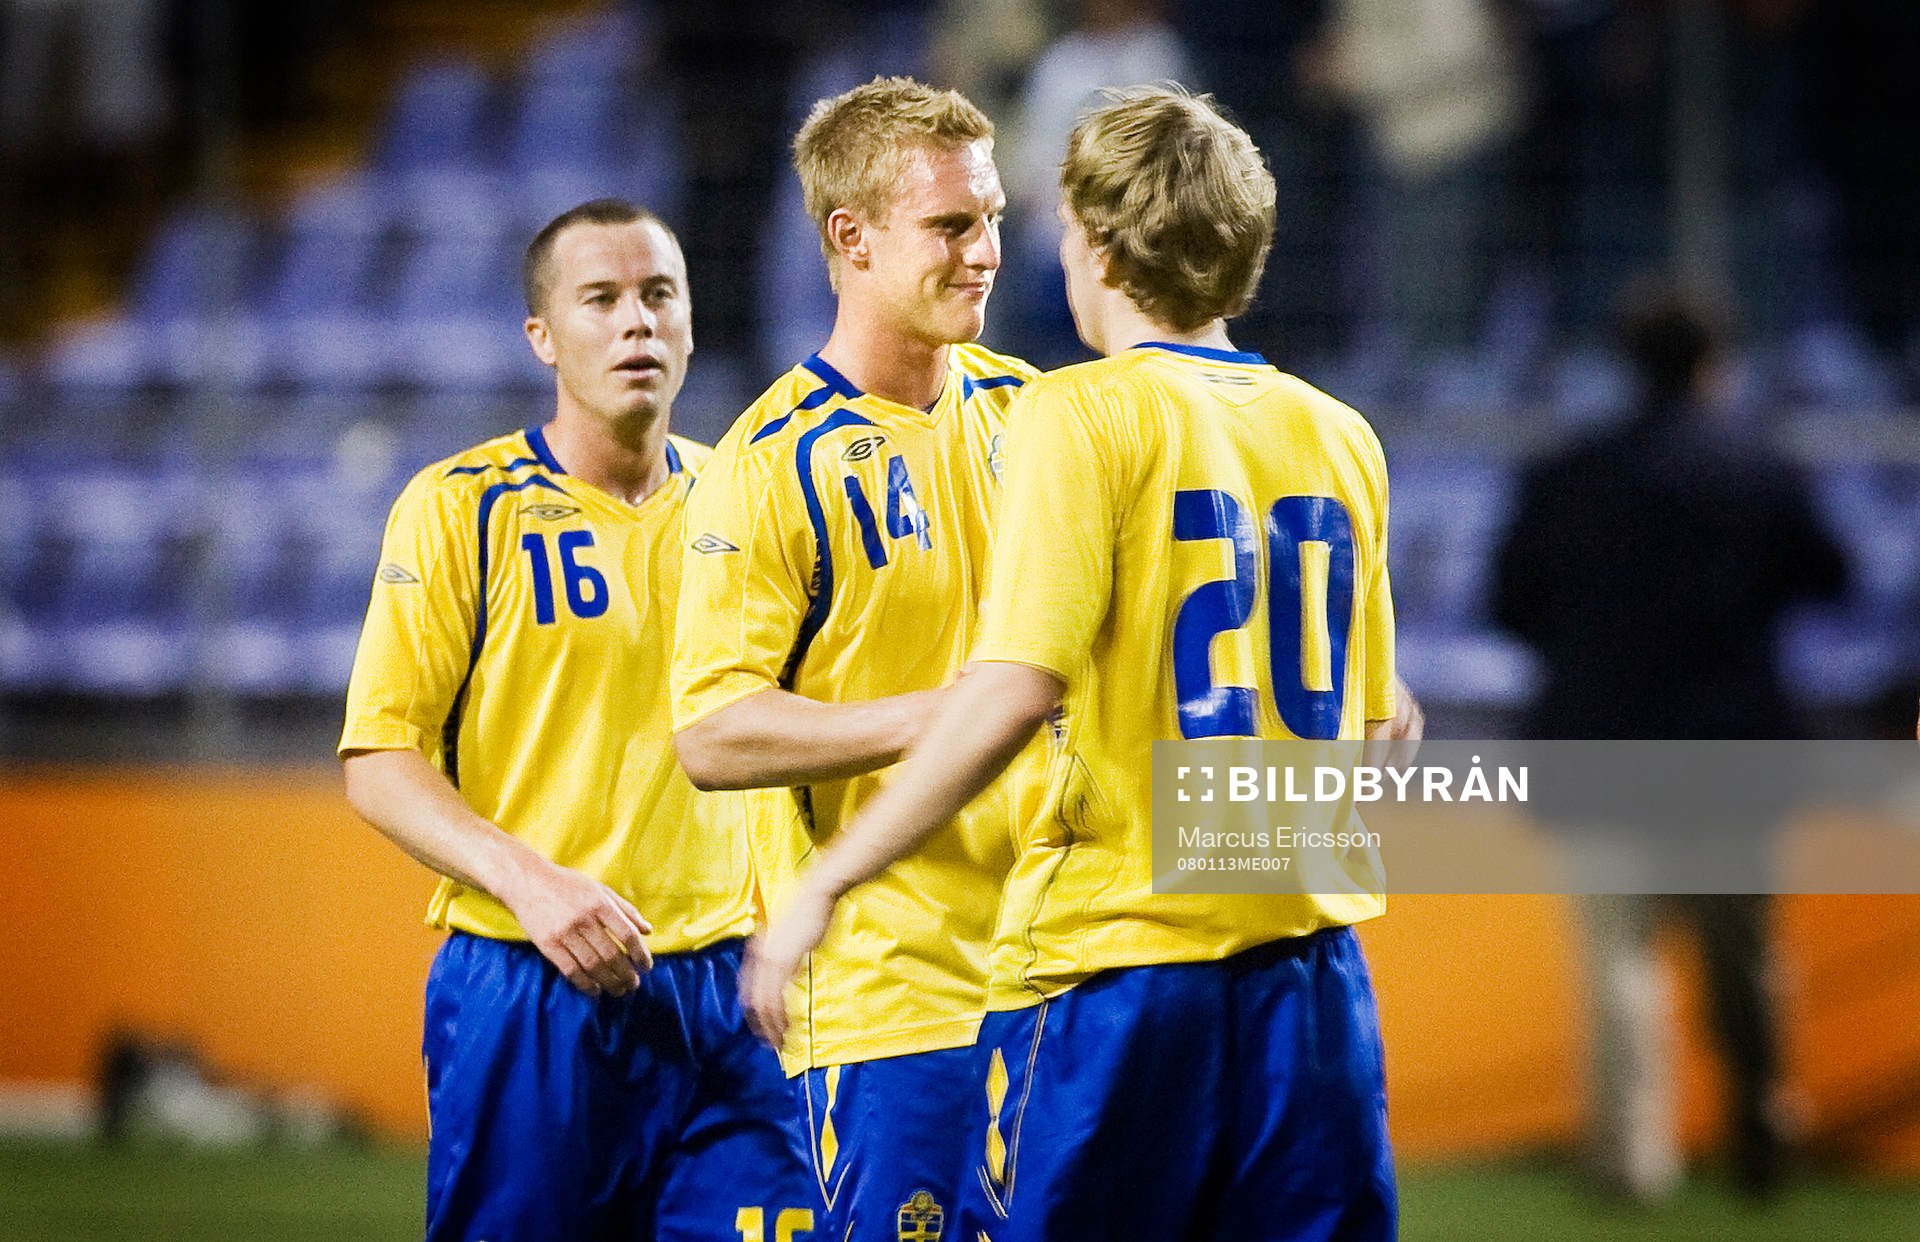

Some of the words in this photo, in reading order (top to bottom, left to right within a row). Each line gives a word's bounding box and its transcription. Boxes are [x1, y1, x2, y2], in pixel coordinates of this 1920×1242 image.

[844, 455, 932, 570] 14
[521, 530, 609, 625] 16
[1173, 489, 1355, 741] 20
